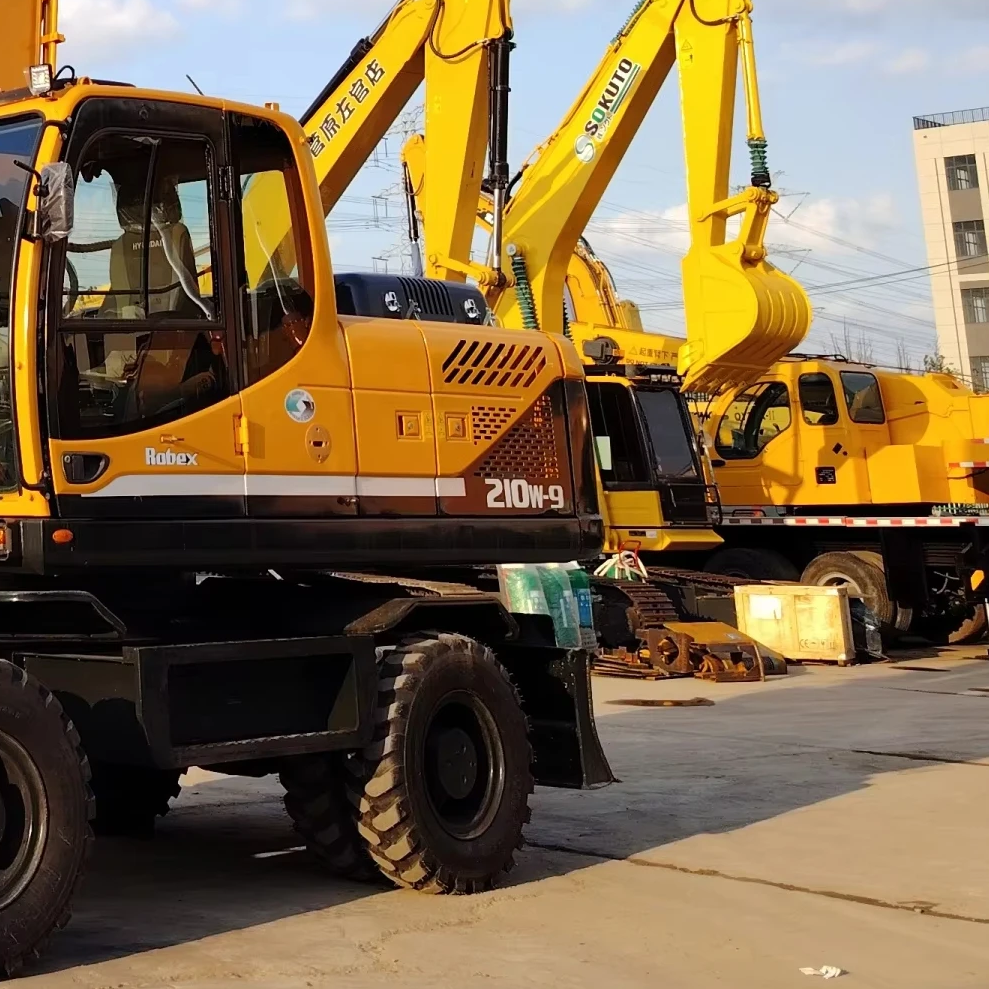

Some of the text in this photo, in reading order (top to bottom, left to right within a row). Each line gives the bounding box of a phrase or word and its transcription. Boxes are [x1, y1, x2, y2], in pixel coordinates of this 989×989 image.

[584, 58, 633, 136] SOKUTO
[132, 239, 163, 251] HYDAI
[145, 447, 199, 466] Robex
[484, 478, 564, 509] 210W-9
